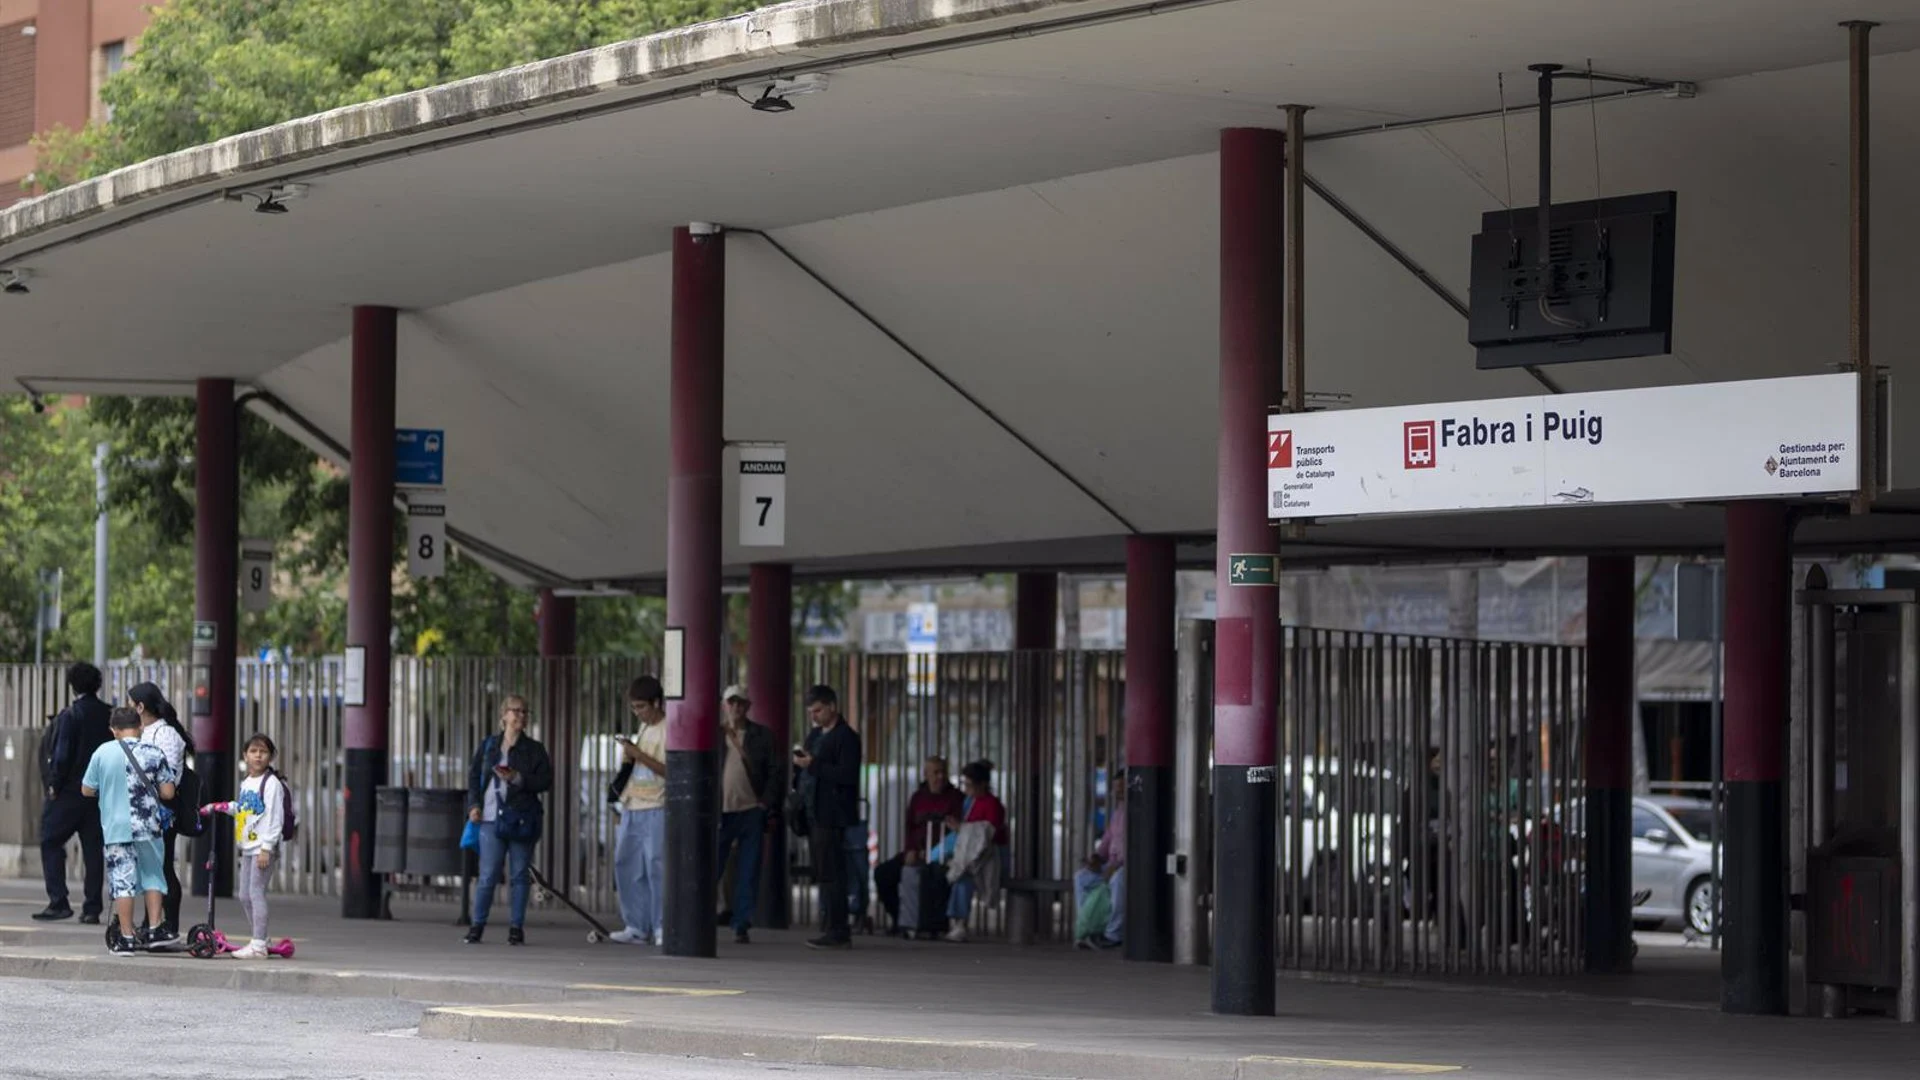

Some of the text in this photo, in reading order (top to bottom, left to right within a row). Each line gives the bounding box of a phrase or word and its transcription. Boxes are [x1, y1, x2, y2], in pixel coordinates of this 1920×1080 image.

[1441, 409, 1602, 448] Fabra i Puig
[1296, 444, 1335, 456] Transports
[1779, 442, 1846, 454] Gestionada per:
[1296, 457, 1323, 469] públics
[1780, 454, 1840, 467] Ajuntament de
[743, 462, 783, 472] ANDANA
[1779, 467, 1821, 478] Barcelona
[1305, 469, 1335, 479] Catalunya
[1283, 482, 1314, 491] Generalitat
[1283, 500, 1310, 508] Catalunya
[756, 496, 773, 527] 7
[418, 533, 433, 559] 8
[251, 566, 262, 591] 9
